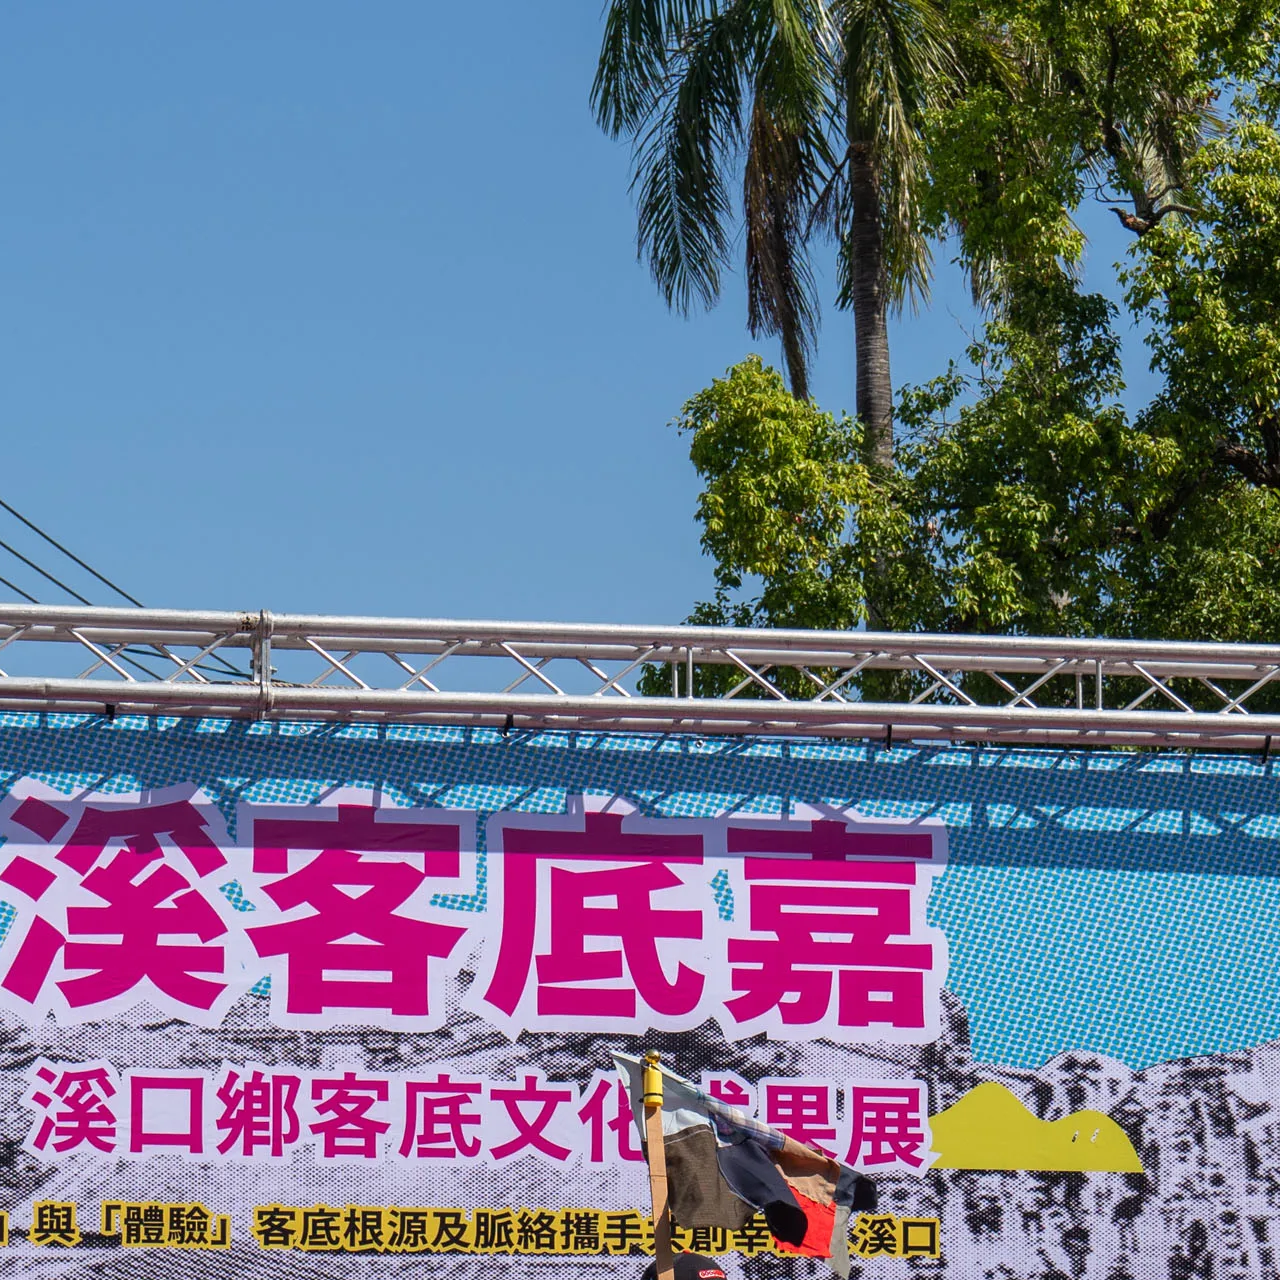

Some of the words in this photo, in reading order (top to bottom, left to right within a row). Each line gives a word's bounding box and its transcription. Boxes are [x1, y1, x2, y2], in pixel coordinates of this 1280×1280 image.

[0, 796, 933, 1028] 溪客底嘉
[31, 1066, 925, 1169] 溪口鄉客底文化果展
